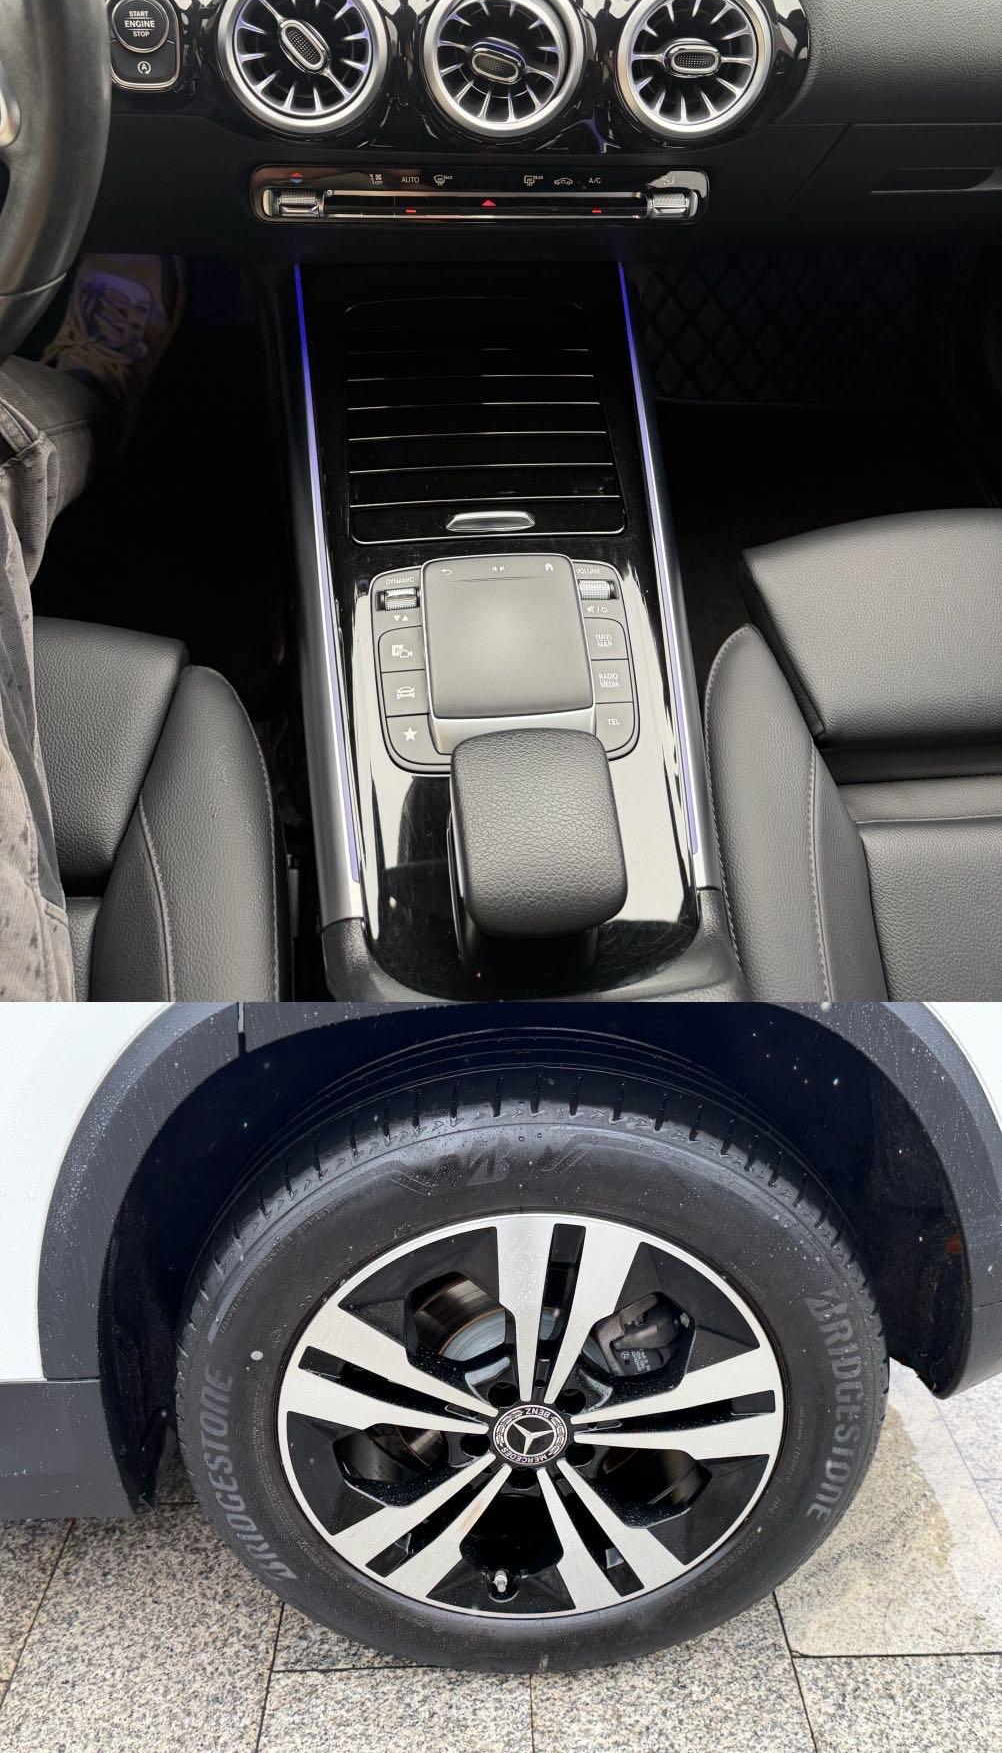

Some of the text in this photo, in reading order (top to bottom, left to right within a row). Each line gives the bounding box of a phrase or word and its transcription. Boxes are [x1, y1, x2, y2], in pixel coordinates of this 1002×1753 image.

[124, 20, 156, 28] ENGINE
[385, 576, 415, 585] DYNAMIC
[804, 1287, 865, 1522] BRIDGESTONE
[525, 1407, 551, 1418] BENZ
[501, 1446, 548, 1463] MERCEDES
[200, 1363, 299, 1581] BRIDGESTONE
